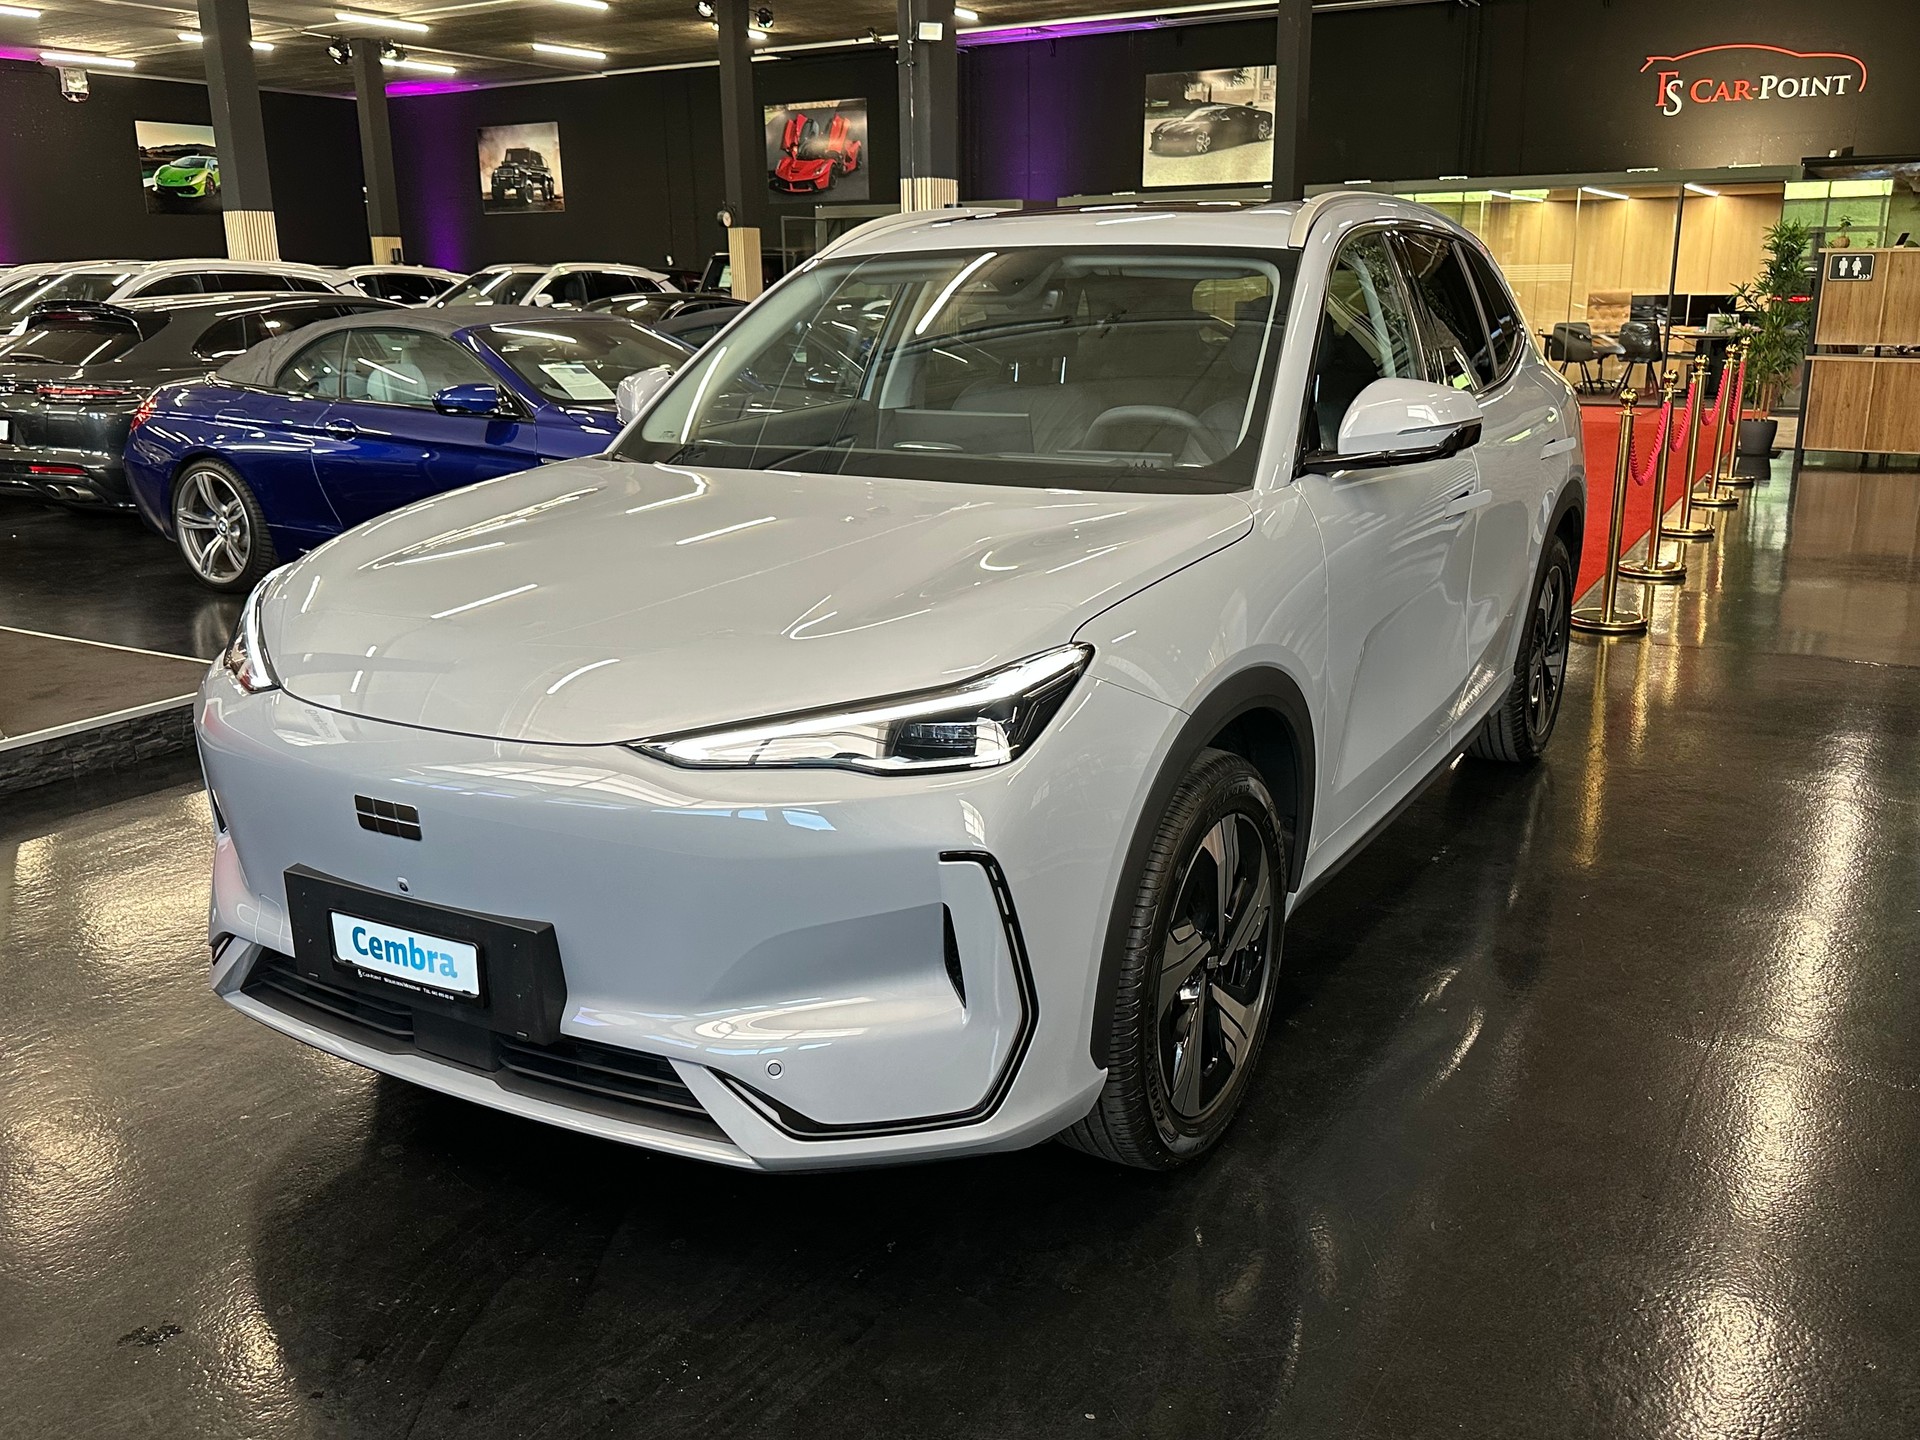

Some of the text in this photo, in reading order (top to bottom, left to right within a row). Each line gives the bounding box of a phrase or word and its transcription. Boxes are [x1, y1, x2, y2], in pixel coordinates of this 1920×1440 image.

[1655, 70, 1852, 117] FS CAR-POINT
[352, 926, 458, 979] Cembra
